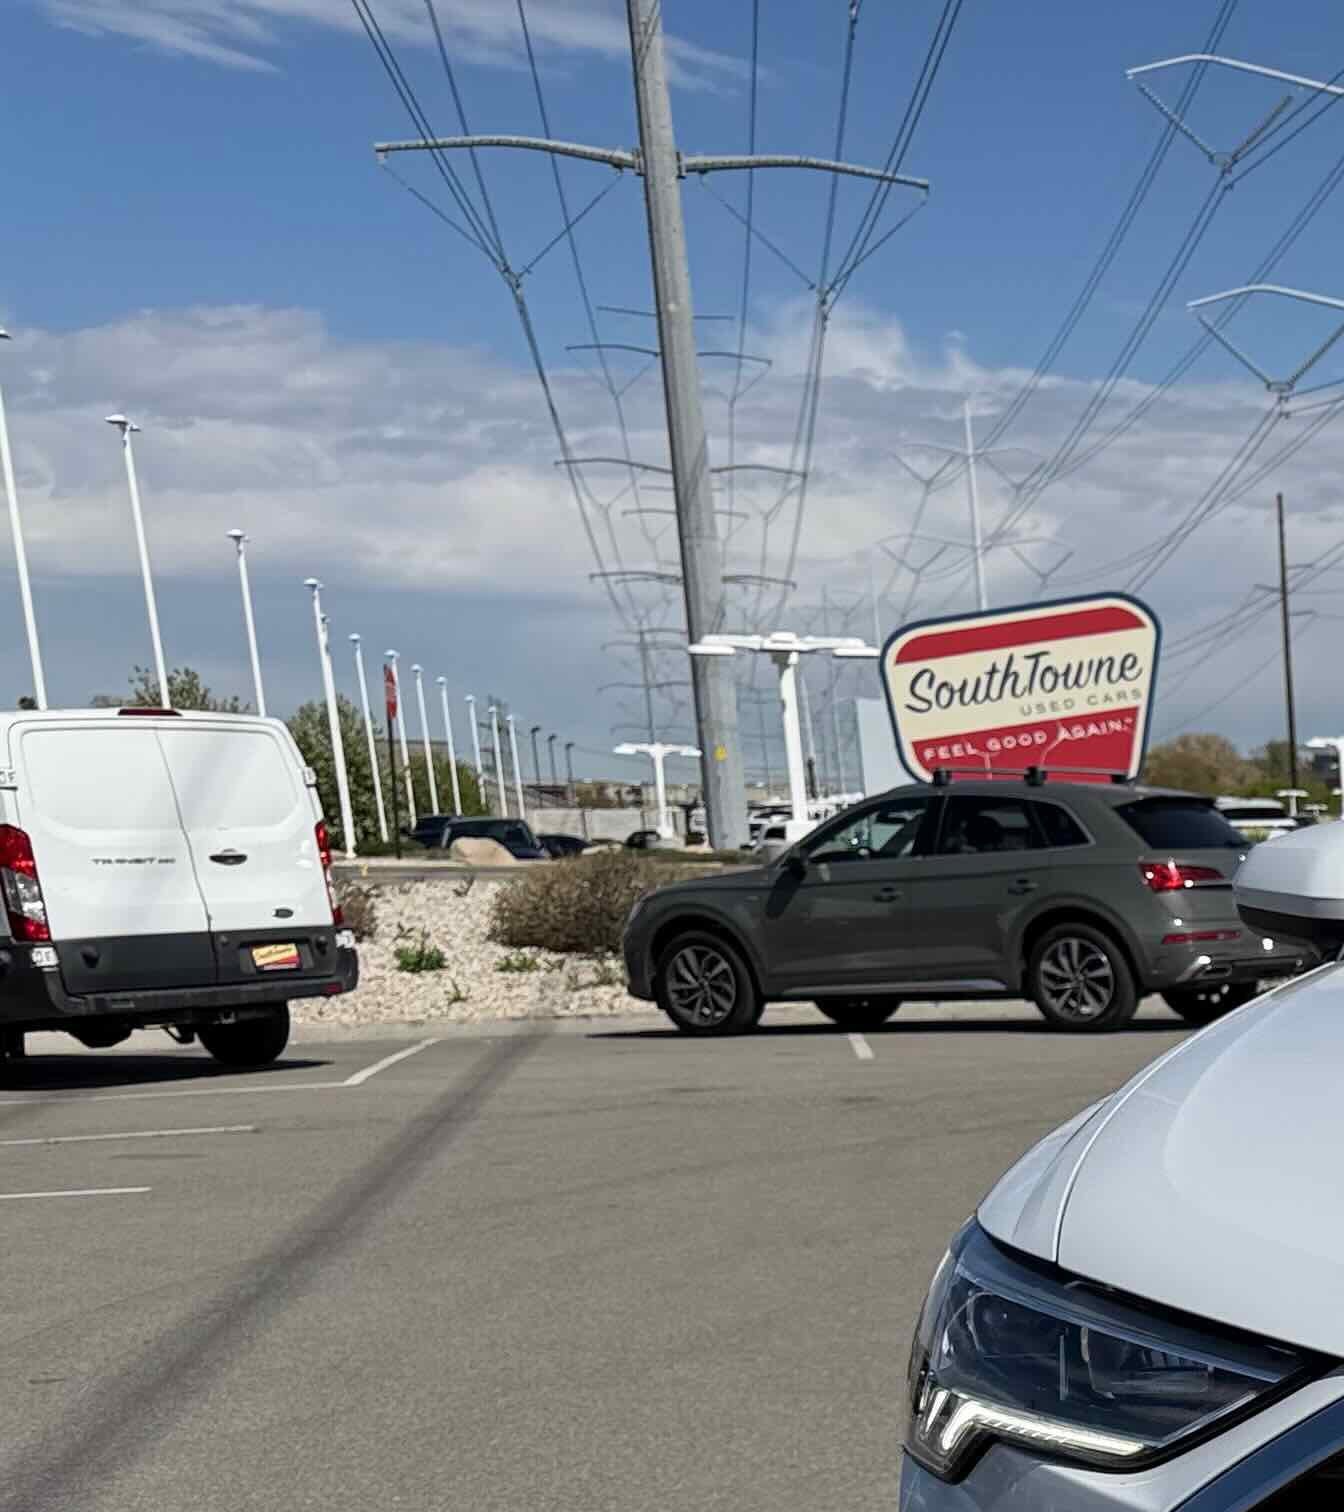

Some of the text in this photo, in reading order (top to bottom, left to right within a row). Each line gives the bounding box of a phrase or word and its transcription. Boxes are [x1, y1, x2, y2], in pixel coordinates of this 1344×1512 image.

[905, 651, 1144, 714] SouthTowne
[1019, 687, 1143, 717] USED CARS
[923, 741, 978, 762] FEEL
[985, 730, 1048, 752] GOOD
